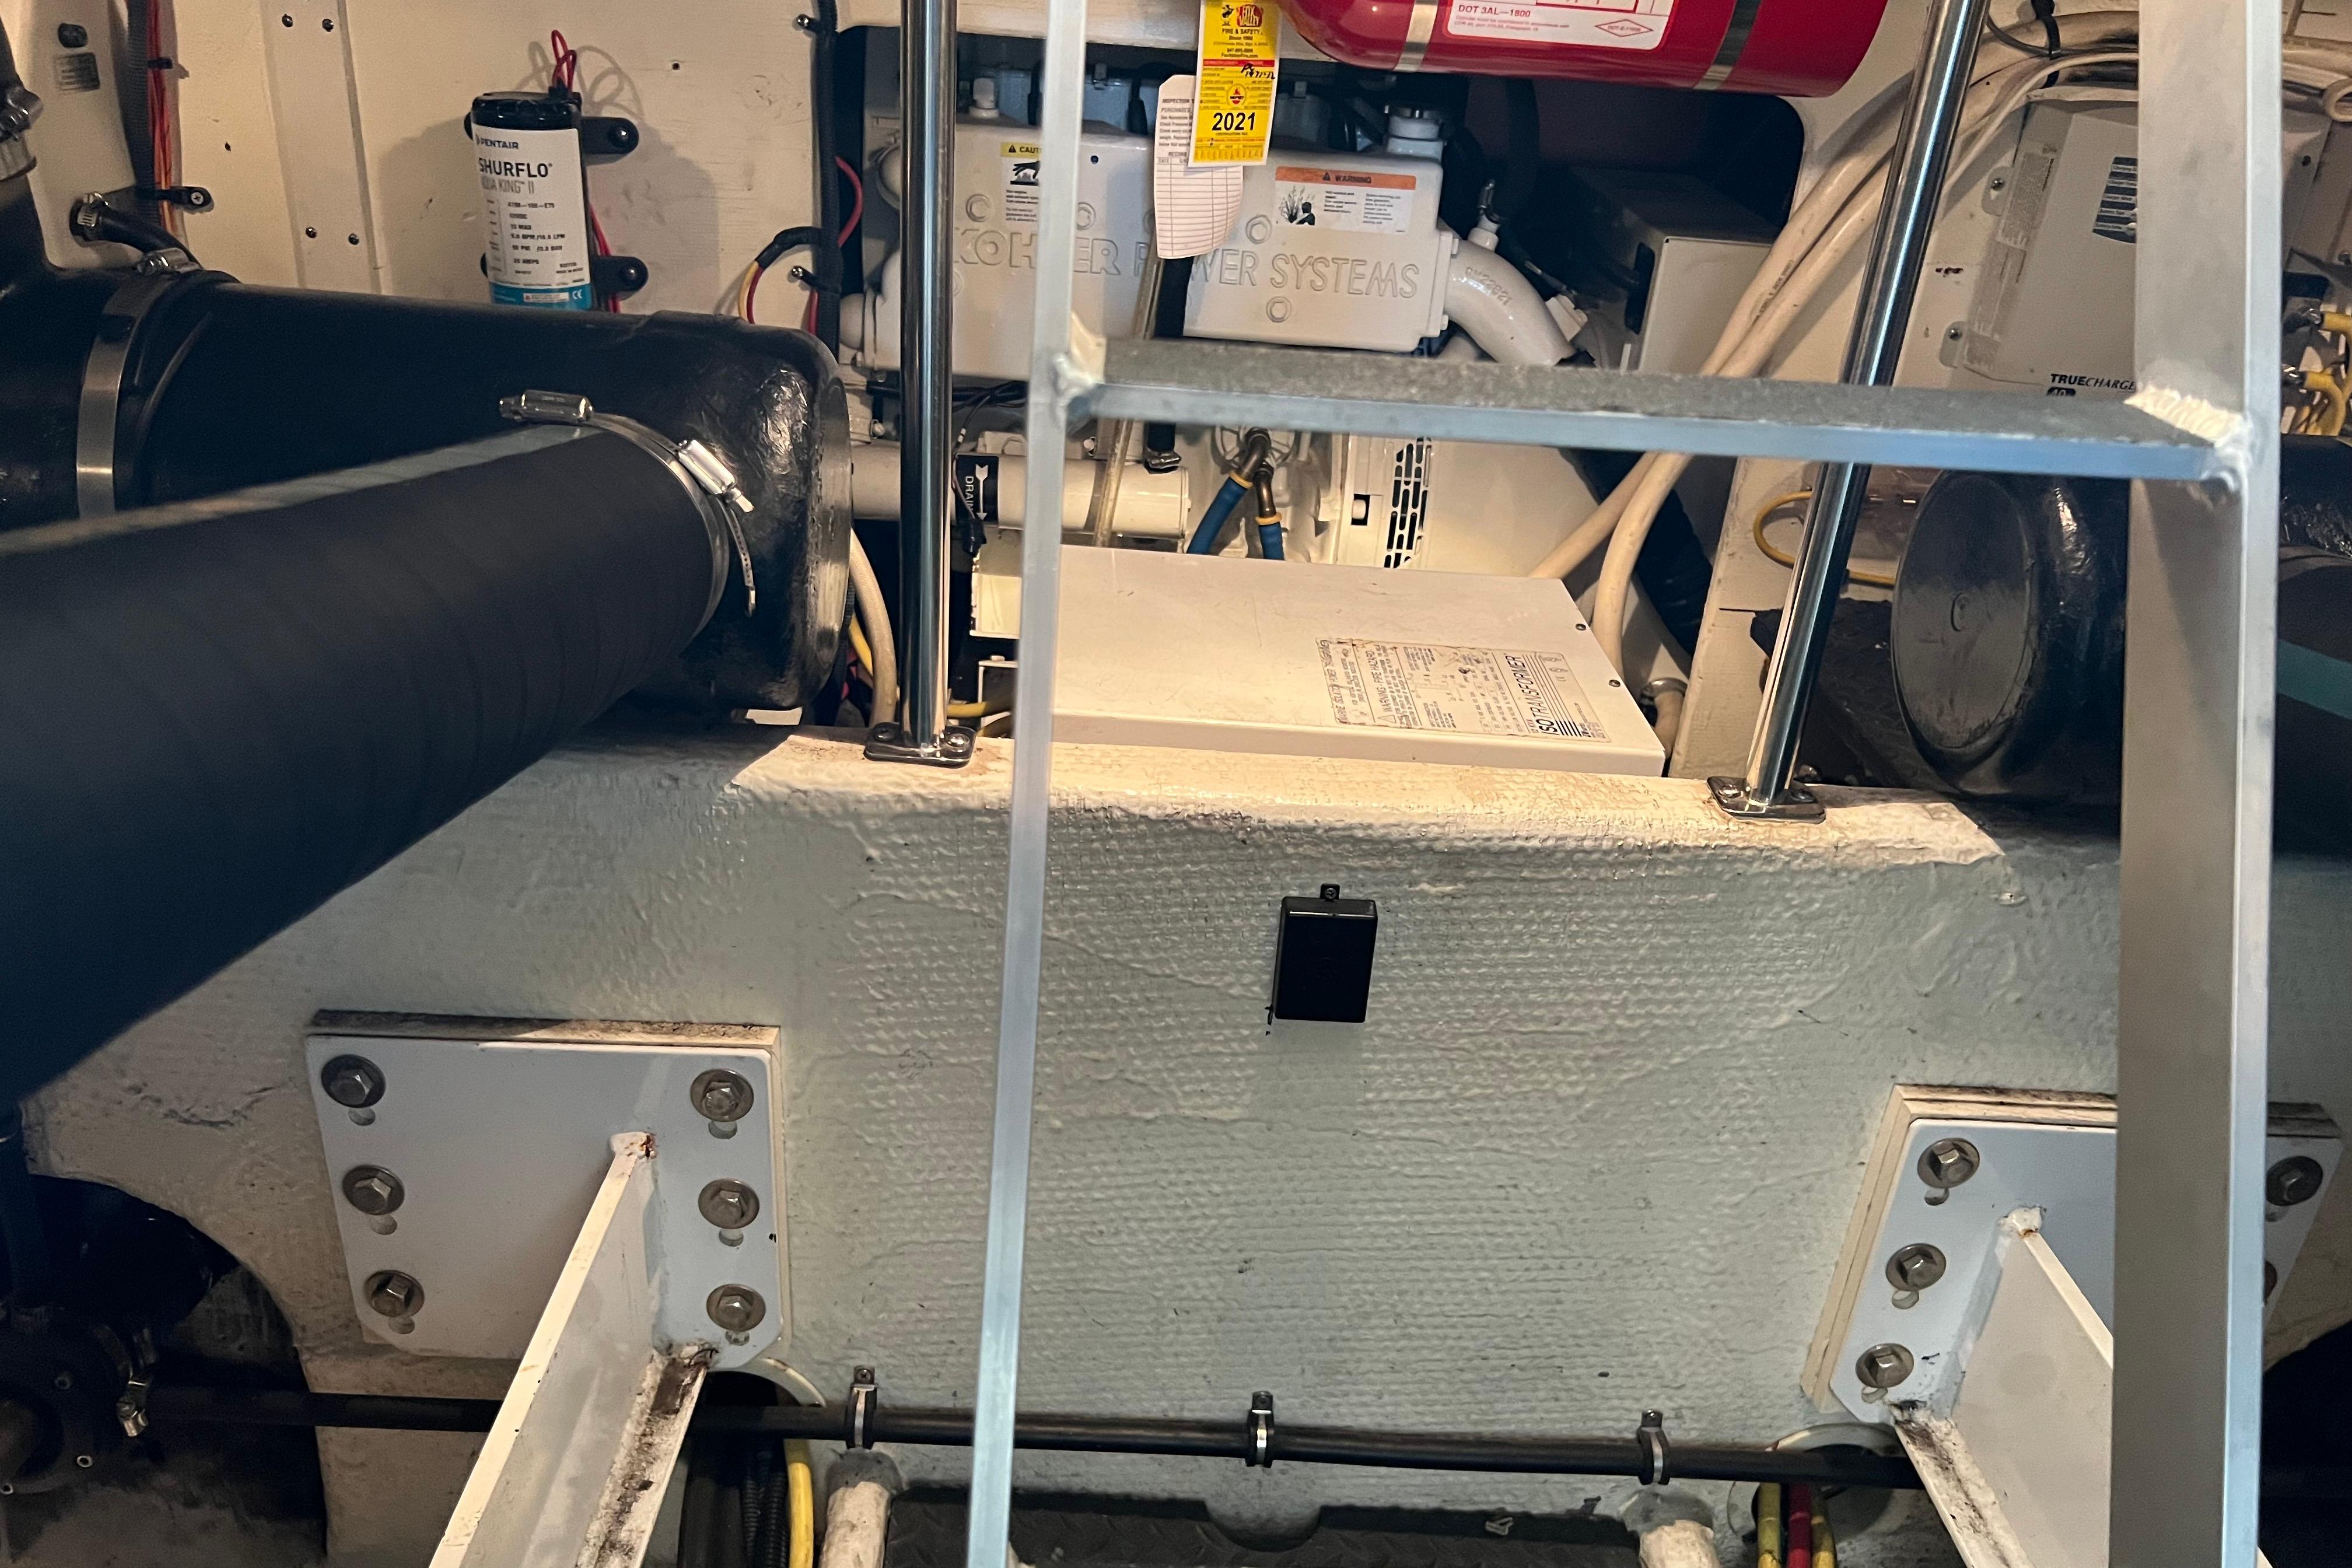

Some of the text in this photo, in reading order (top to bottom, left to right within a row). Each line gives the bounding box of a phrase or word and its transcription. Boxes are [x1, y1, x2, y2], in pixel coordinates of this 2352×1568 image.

[1458, 5, 1479, 13] DOT
[1212, 112, 1255, 131] 2021
[481, 138, 519, 149] PENTAIR
[1335, 175, 1372, 184] WARNING
[954, 227, 1419, 299] KOHER PWER SYSTEMS
[2050, 373, 2137, 391] TRUECHARGE
[1364, 650, 1380, 670] HAZARD
[1370, 671, 1384, 682] FIRE
[1375, 687, 1393, 712] WARNING
[1504, 654, 1559, 735] ISOTRANSFORMER
